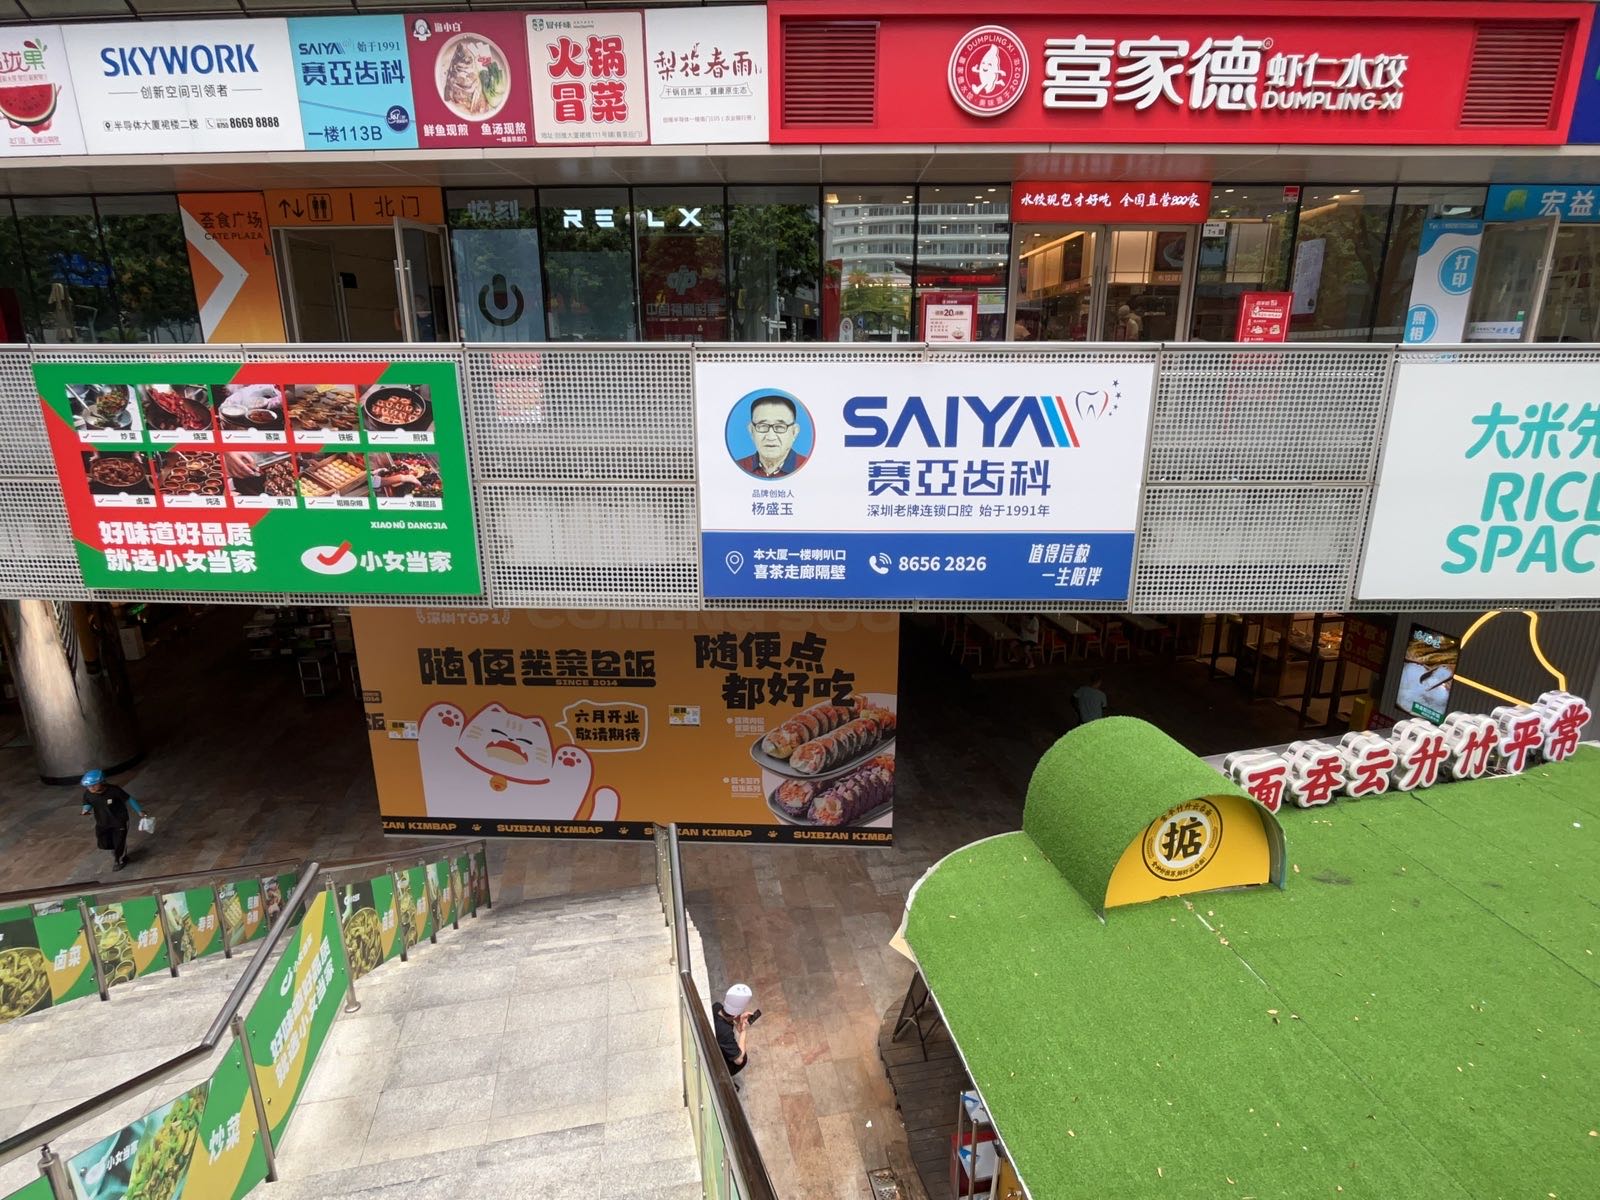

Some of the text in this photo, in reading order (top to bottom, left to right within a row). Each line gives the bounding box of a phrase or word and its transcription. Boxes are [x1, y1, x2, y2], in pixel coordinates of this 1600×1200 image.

[298, 42, 341, 55] SAIYA
[357, 41, 400, 52] 始于1991
[967, 35, 1007, 51] DUMPLING
[100, 43, 259, 77] SKYWORK
[547, 36, 626, 78] 火锅
[653, 47, 753, 81] 梨花春雨
[1042, 34, 1264, 111] 喜家德
[1266, 52, 1409, 89] 虾仁水饺
[141, 84, 228, 99] 创新空间引领者
[552, 81, 627, 122] 冒菜
[114, 119, 199, 130] 半导体大厦裙楼二楼
[230, 117, 254, 128] 8669
[256, 116, 280, 128] 8888
[423, 122, 527, 136] 鲜鱼现煎 鱼汤现熬
[308, 126, 382, 142] 一楼113B
[374, 195, 420, 218] 北门
[1020, 192, 1201, 208] 水饺现包才好吃 全国直营800家
[200, 211, 263, 230] 荟食广场
[563, 207, 702, 228] RELX
[204, 231, 264, 240] CATE PLAZA
[1452, 255, 1471, 287] 打印
[842, 395, 1058, 448] SAIYA
[120, 432, 137, 440] 炒菜
[338, 433, 354, 441] 铁板
[752, 489, 795, 498] 品牌创始人
[276, 498, 292, 506] 寿司
[409, 500, 437, 508] 水果甜品
[752, 502, 794, 516] 杨盛玉
[867, 504, 1050, 518] 深圳老牌连锁口腔 始于1991年
[97, 520, 253, 547] 好味道好品质
[370, 521, 392, 529] XIAO
[407, 521, 432, 530] DANG
[433, 522, 448, 530] JIA
[104, 547, 258, 573] 就选小女当家
[360, 550, 453, 573] 小女当家
[753, 548, 846, 561] 本大厦一楼喇叭口
[1028, 543, 1091, 564] 值得信赖
[753, 564, 846, 580] 喜茶走廊隔壁
[898, 556, 987, 572] 8656 2826
[1041, 566, 1102, 586] 一生陪伴
[694, 631, 827, 674] 随便点
[556, 679, 619, 687] SINCE 2014
[721, 669, 856, 710] 都好吃
[575, 709, 640, 724] 六月开业
[575, 727, 642, 743] 敬请期待
[408, 822, 457, 832] KIMBAP
[496, 823, 604, 835] SUIBIAN KIMBAP
[702, 829, 753, 838] KIMBAP
[793, 830, 849, 841] SUIBIAN
[1161, 816, 1204, 861] 掂
[53, 945, 82, 972] 卤菜
[270, 934, 331, 1064] 好味道好品质
[275, 956, 335, 1089] 就选小女当家
[208, 1112, 241, 1166] 炒菜
